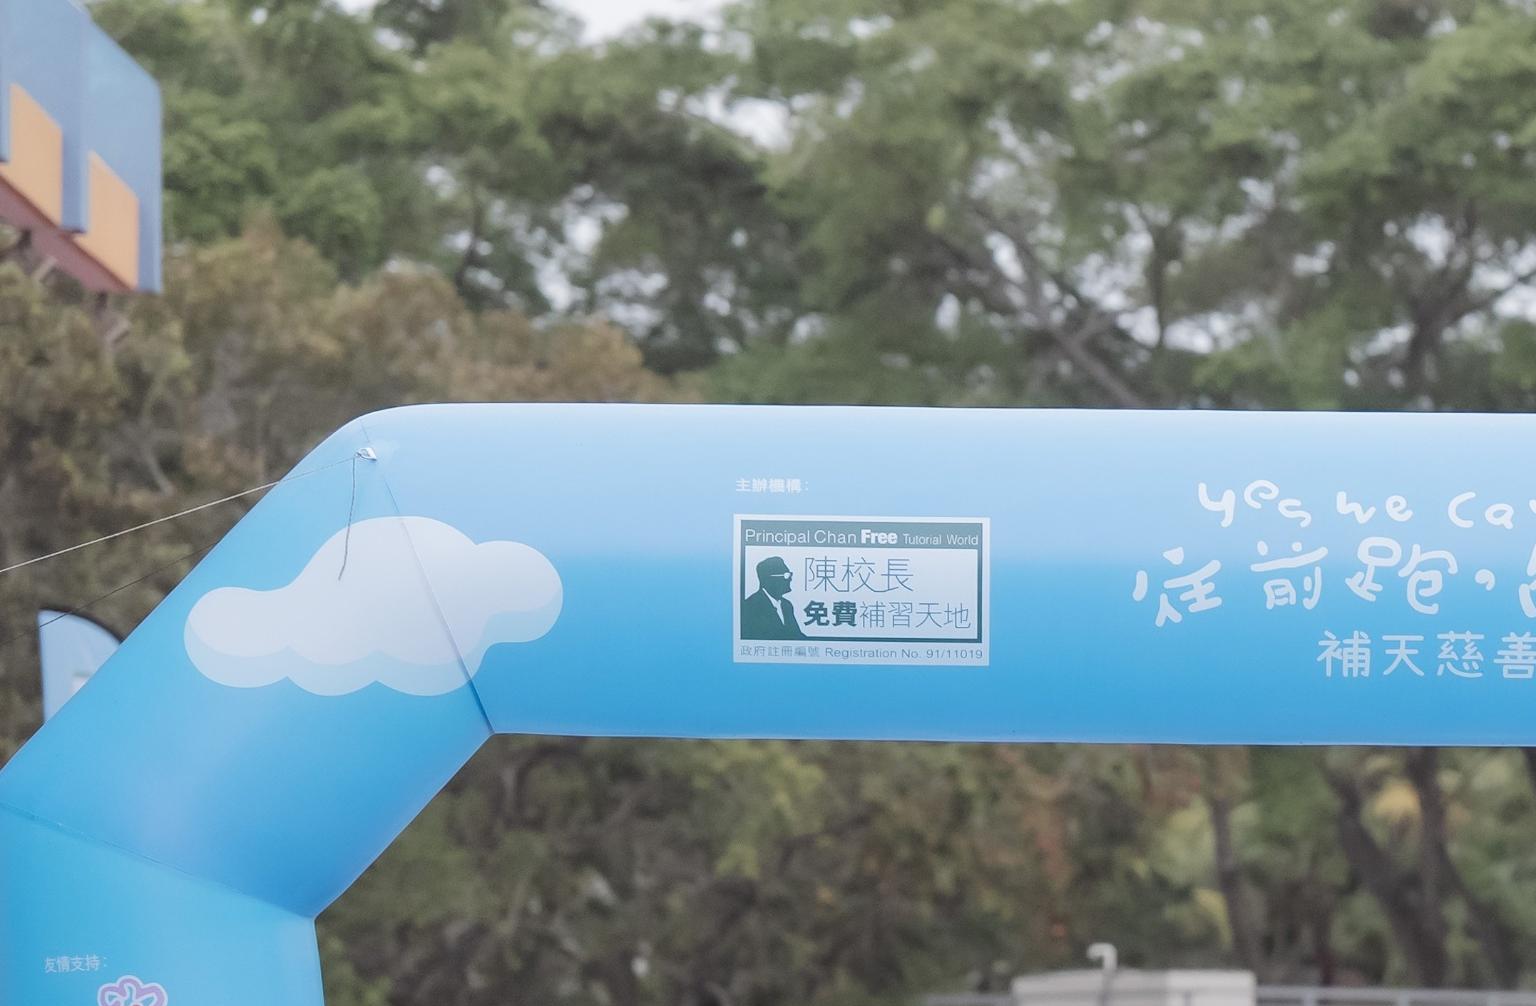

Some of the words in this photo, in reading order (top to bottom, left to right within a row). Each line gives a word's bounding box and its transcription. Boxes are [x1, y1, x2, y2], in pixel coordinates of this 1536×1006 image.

[1198, 479, 1312, 528] yes
[1336, 491, 1414, 524] we
[745, 529, 810, 545] Principal
[814, 530, 857, 544] Chan
[861, 529, 898, 545] Free
[903, 533, 942, 545] Tutorial
[947, 534, 979, 546] World
[804, 555, 914, 593] 陳校長
[803, 600, 972, 630] 免費補習天地
[825, 647, 898, 660] Registration
[901, 648, 921, 659] No.
[926, 648, 984, 660] 91/11019
